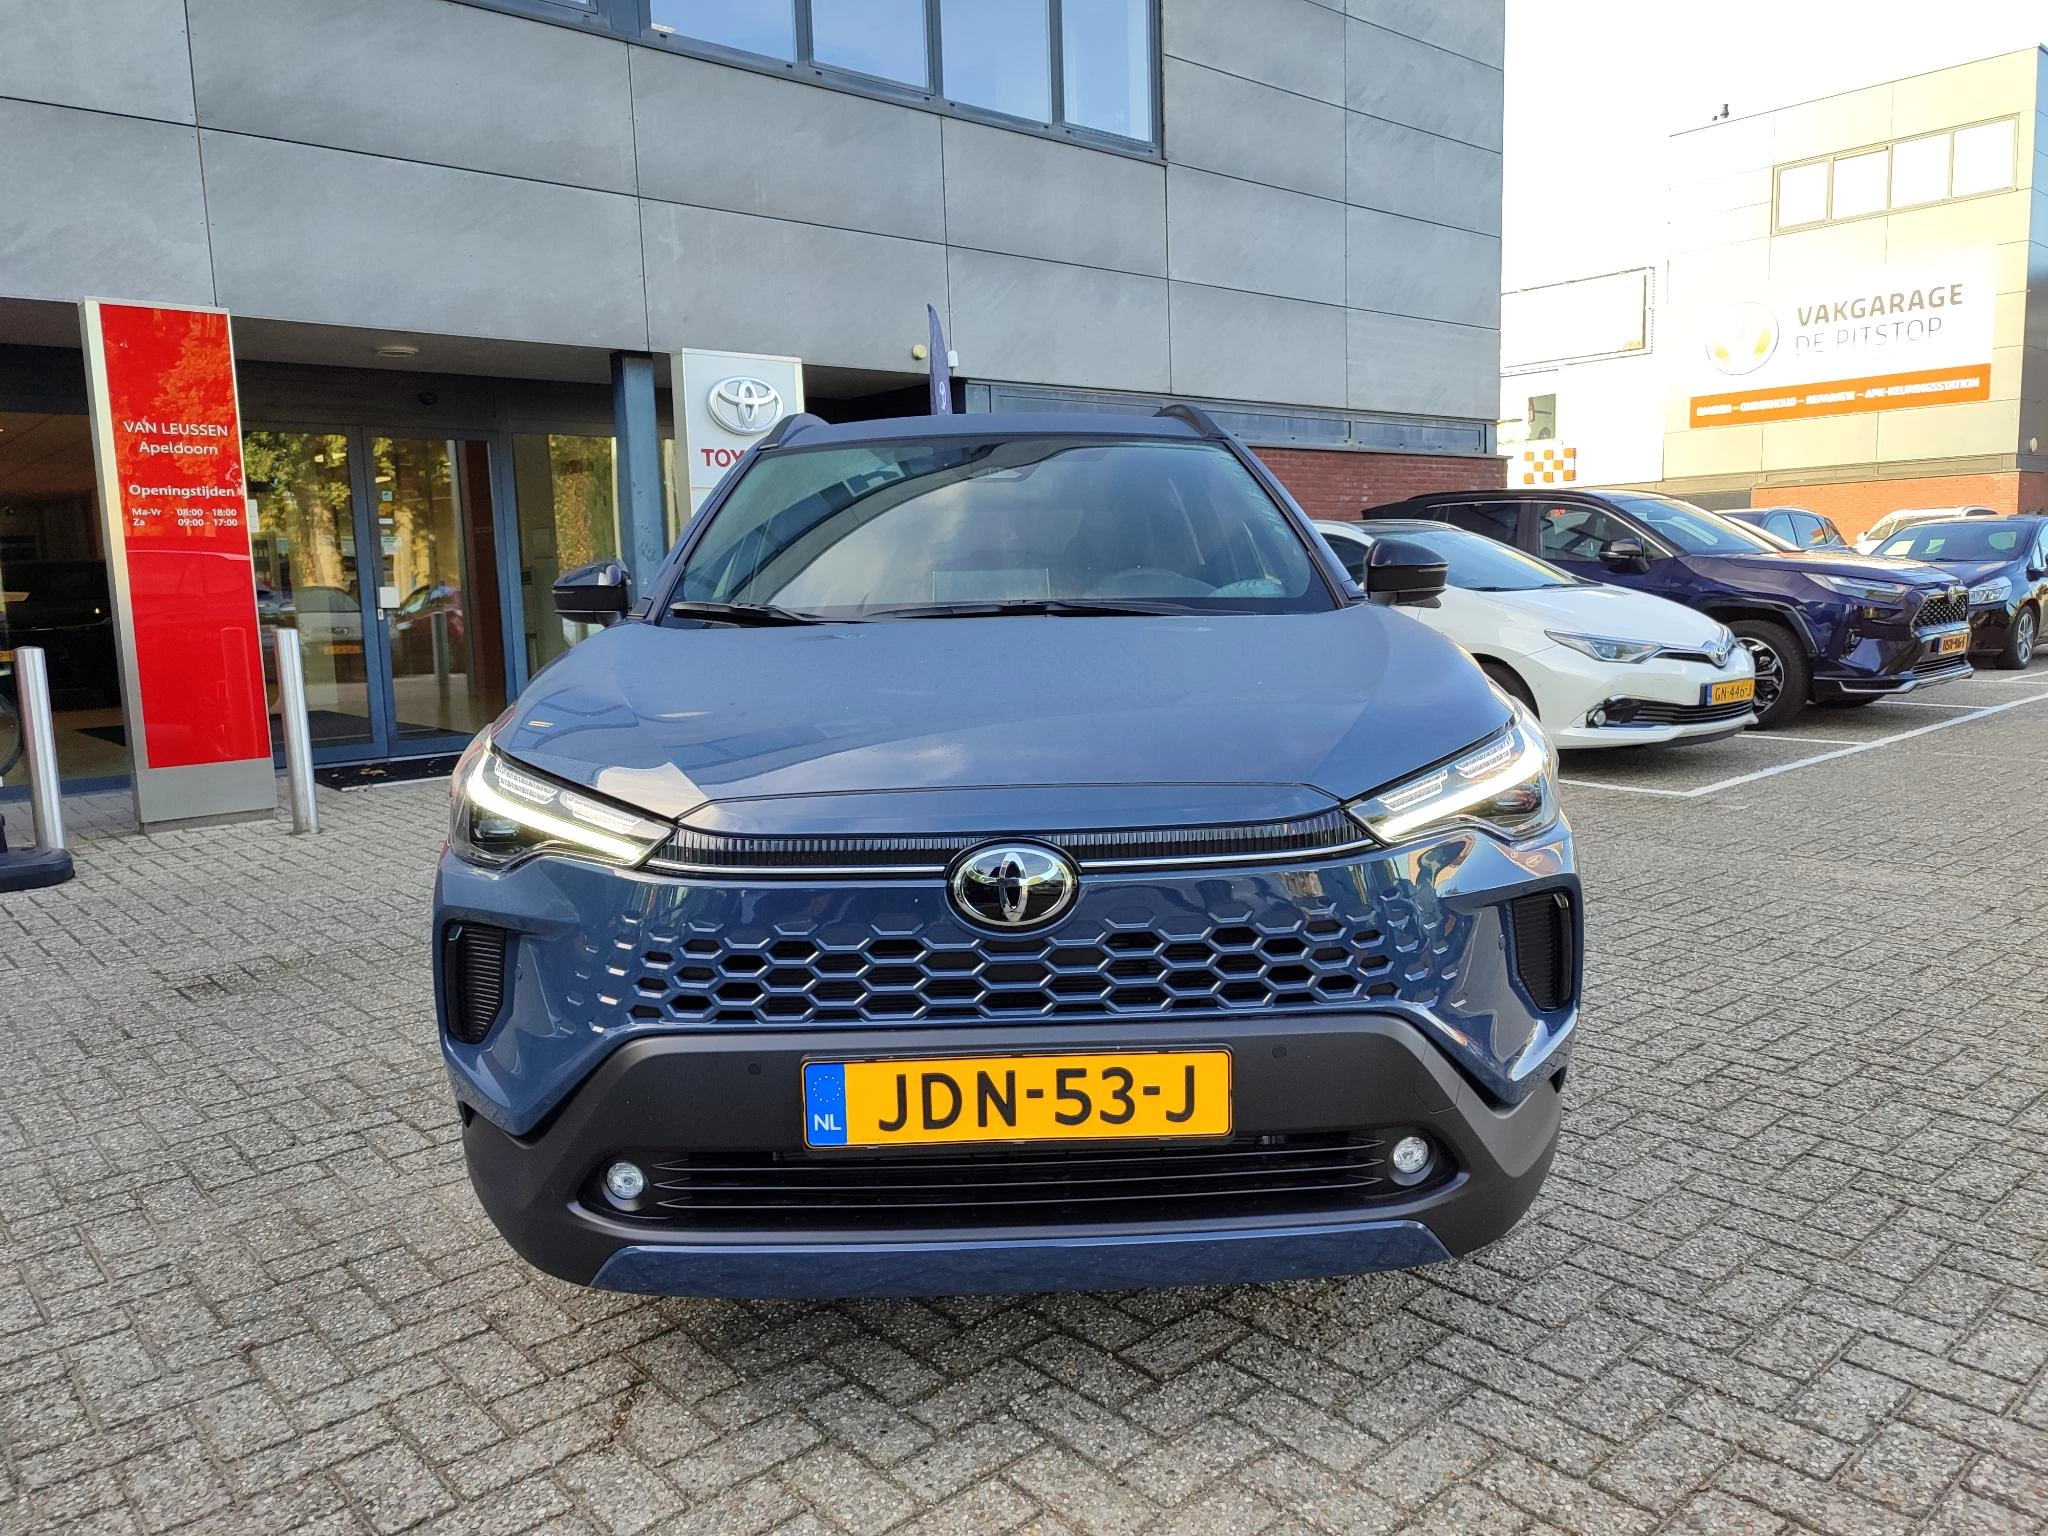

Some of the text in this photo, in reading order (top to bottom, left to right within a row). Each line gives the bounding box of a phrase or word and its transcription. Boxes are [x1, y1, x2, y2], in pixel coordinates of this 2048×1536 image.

[1797, 283, 1963, 327] VAKGARAGE
[1795, 316, 1942, 355] DE PITSTOP
[123, 420, 229, 437] VAN LEUSSEN
[139, 440, 218, 456] Apeldoorn
[701, 448, 746, 468] TOY
[129, 484, 235, 499] Openingstijden
[132, 507, 162, 517] Ma-Vr
[176, 508, 204, 517] 08:00
[212, 508, 237, 518] 18:00
[133, 518, 146, 527] Za
[177, 518, 205, 527] 09:00
[213, 518, 239, 527] 17:00
[813, 1064, 1196, 1132] NL JDN-53-J
